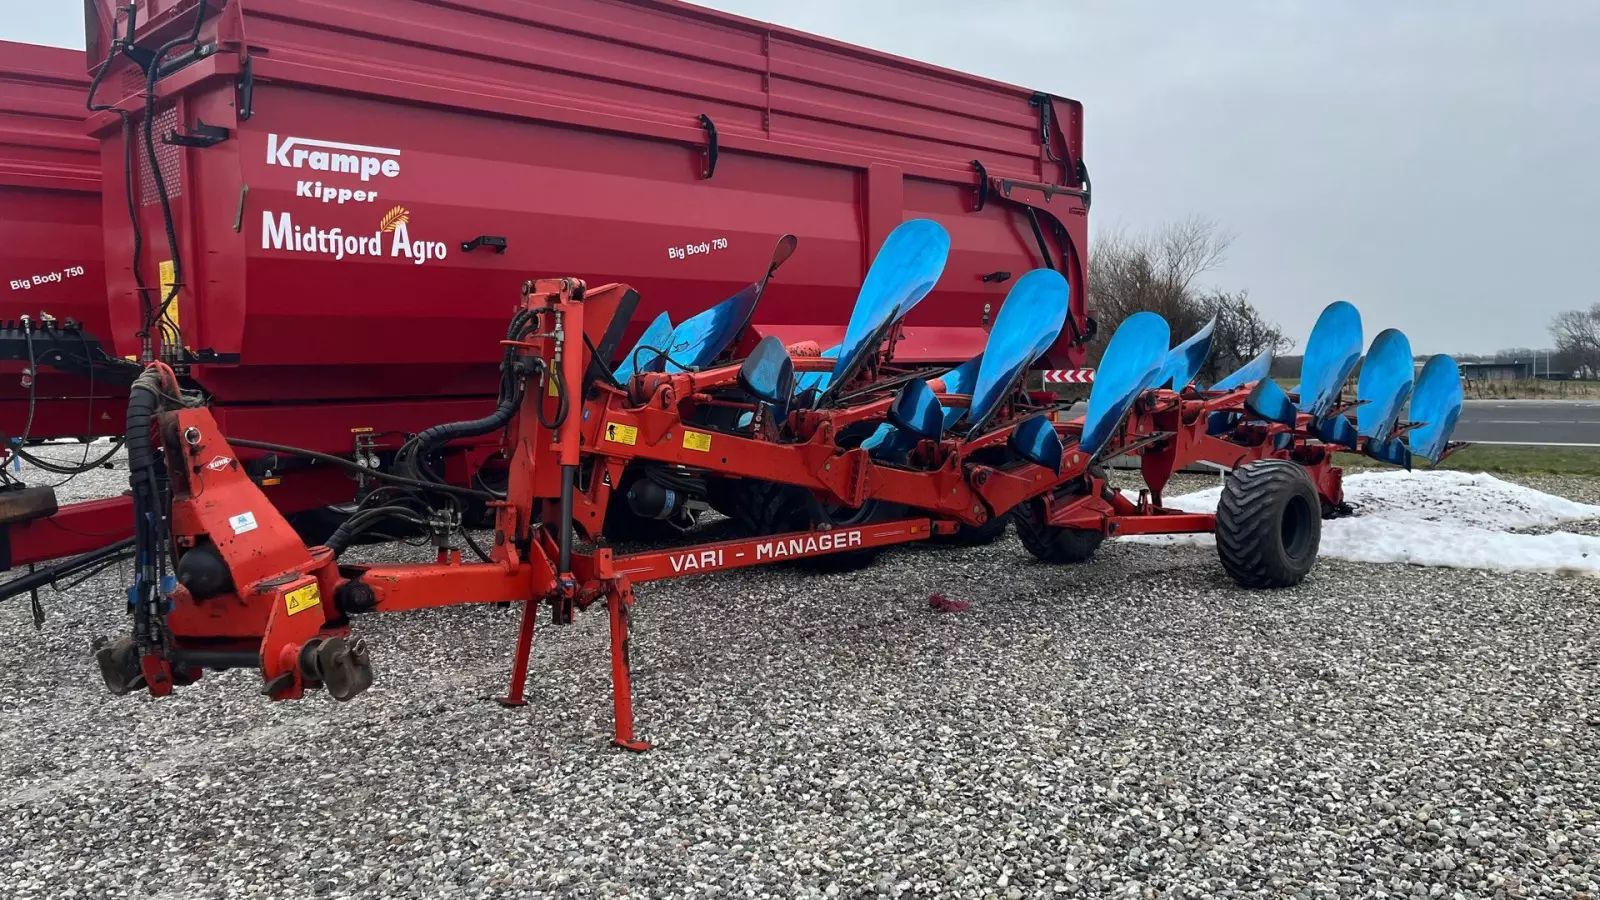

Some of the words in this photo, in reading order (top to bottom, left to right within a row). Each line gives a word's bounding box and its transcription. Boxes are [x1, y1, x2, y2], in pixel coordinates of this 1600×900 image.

[266, 133, 401, 182] Krampe
[296, 180, 378, 204] Kipper
[262, 210, 382, 260] Midtfjord
[391, 221, 447, 265] Agro
[667, 246, 685, 259] Big
[686, 241, 710, 255] Body
[711, 237, 728, 250] 750
[9, 279, 31, 290] Big
[31, 271, 62, 285] Body
[63, 265, 84, 278] 750
[670, 549, 724, 573] VARI
[756, 530, 862, 560] MANAGER
